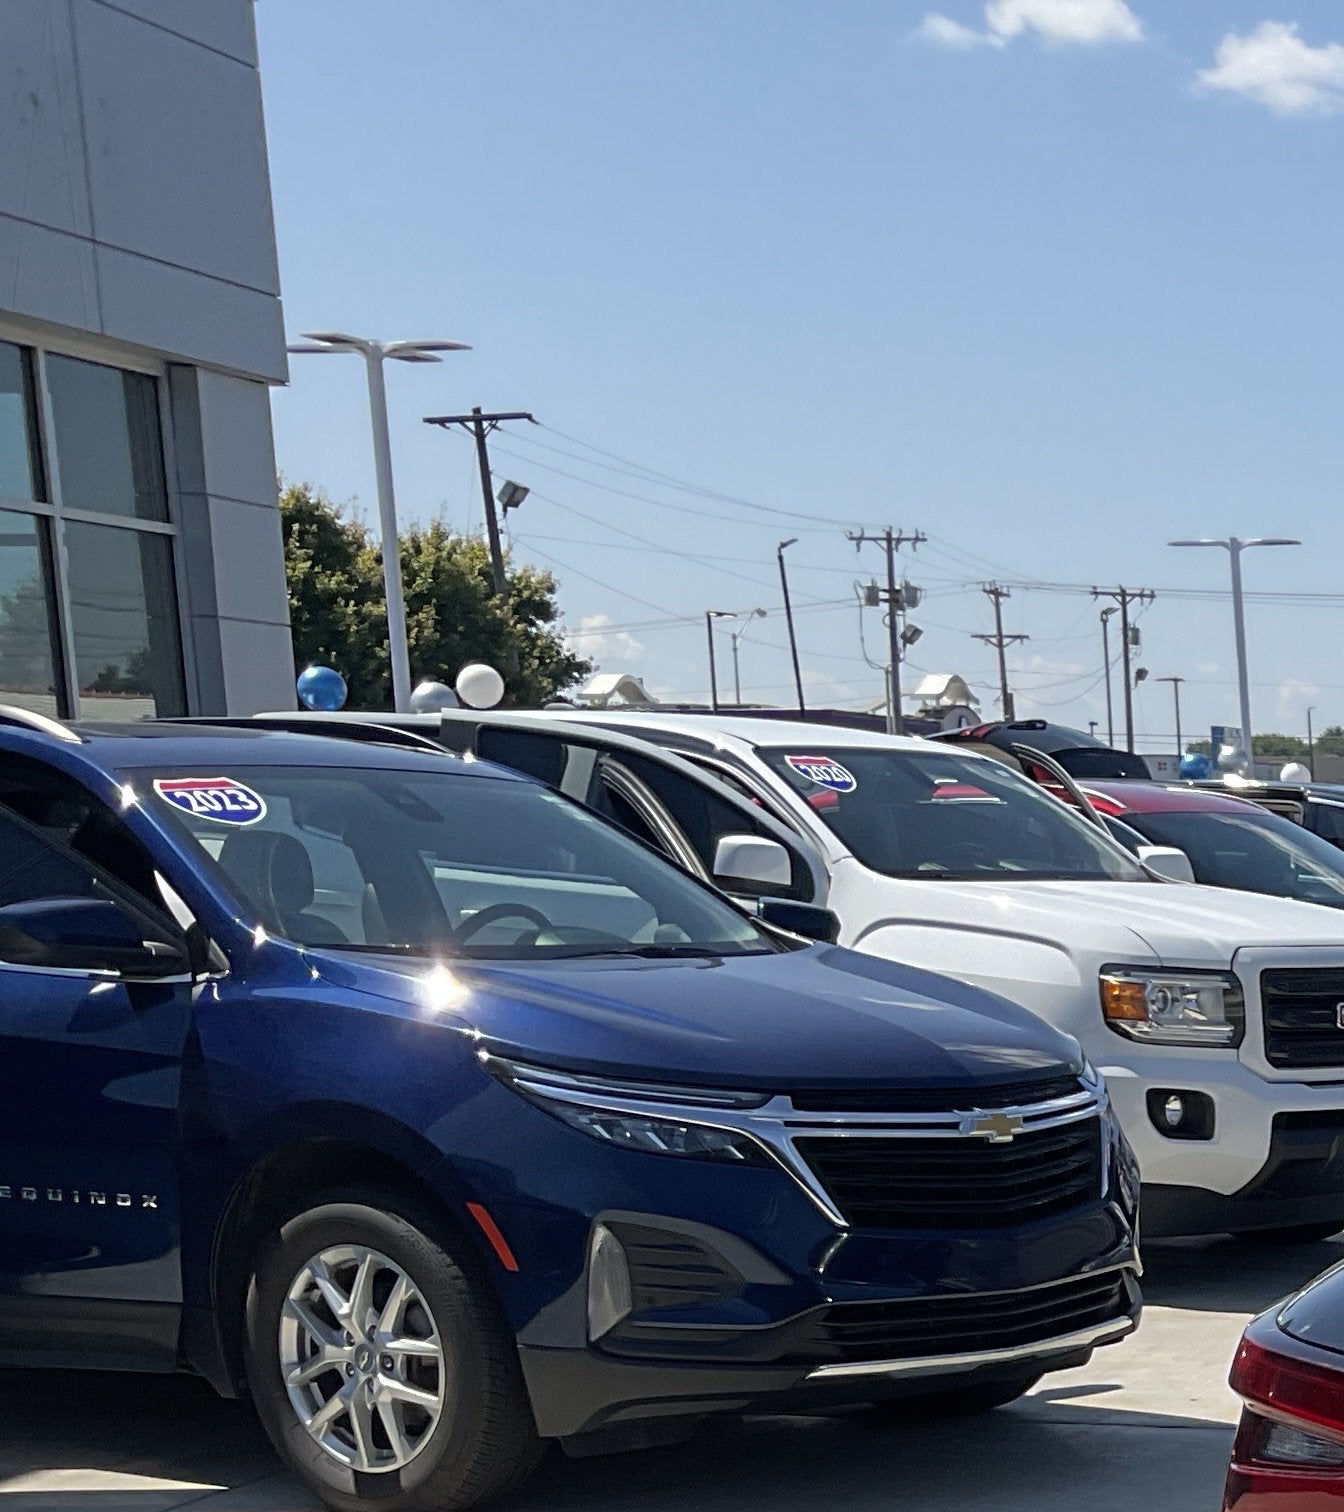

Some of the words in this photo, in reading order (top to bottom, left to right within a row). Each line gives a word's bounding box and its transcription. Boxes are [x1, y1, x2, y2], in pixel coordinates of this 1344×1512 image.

[799, 765, 852, 782] 2020
[174, 789, 259, 812] 2023
[0, 1185, 158, 1209] EQUINOX
